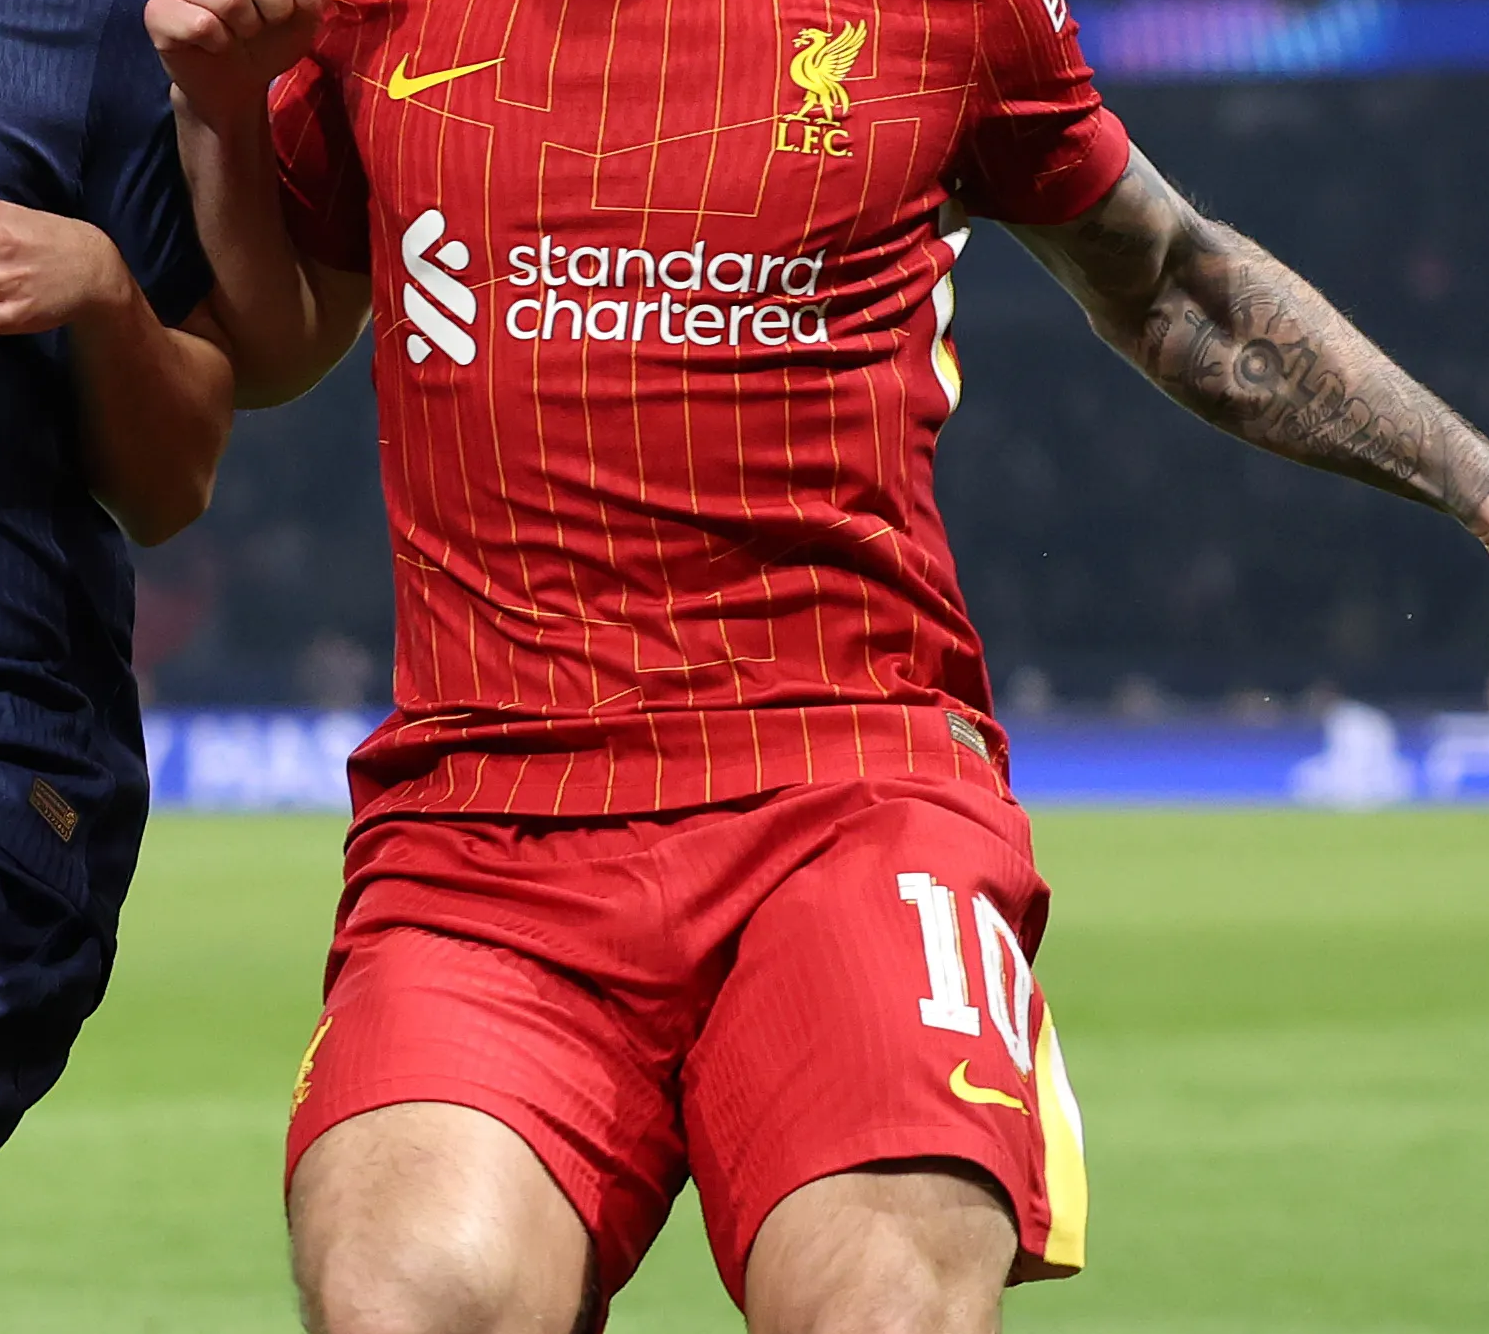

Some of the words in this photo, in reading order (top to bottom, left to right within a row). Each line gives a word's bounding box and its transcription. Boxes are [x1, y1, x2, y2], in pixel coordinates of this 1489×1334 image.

[775, 121, 854, 157] L.F.C.
[507, 234, 827, 297] standard
[505, 288, 833, 347] chartered
[896, 872, 1034, 1079] 10
